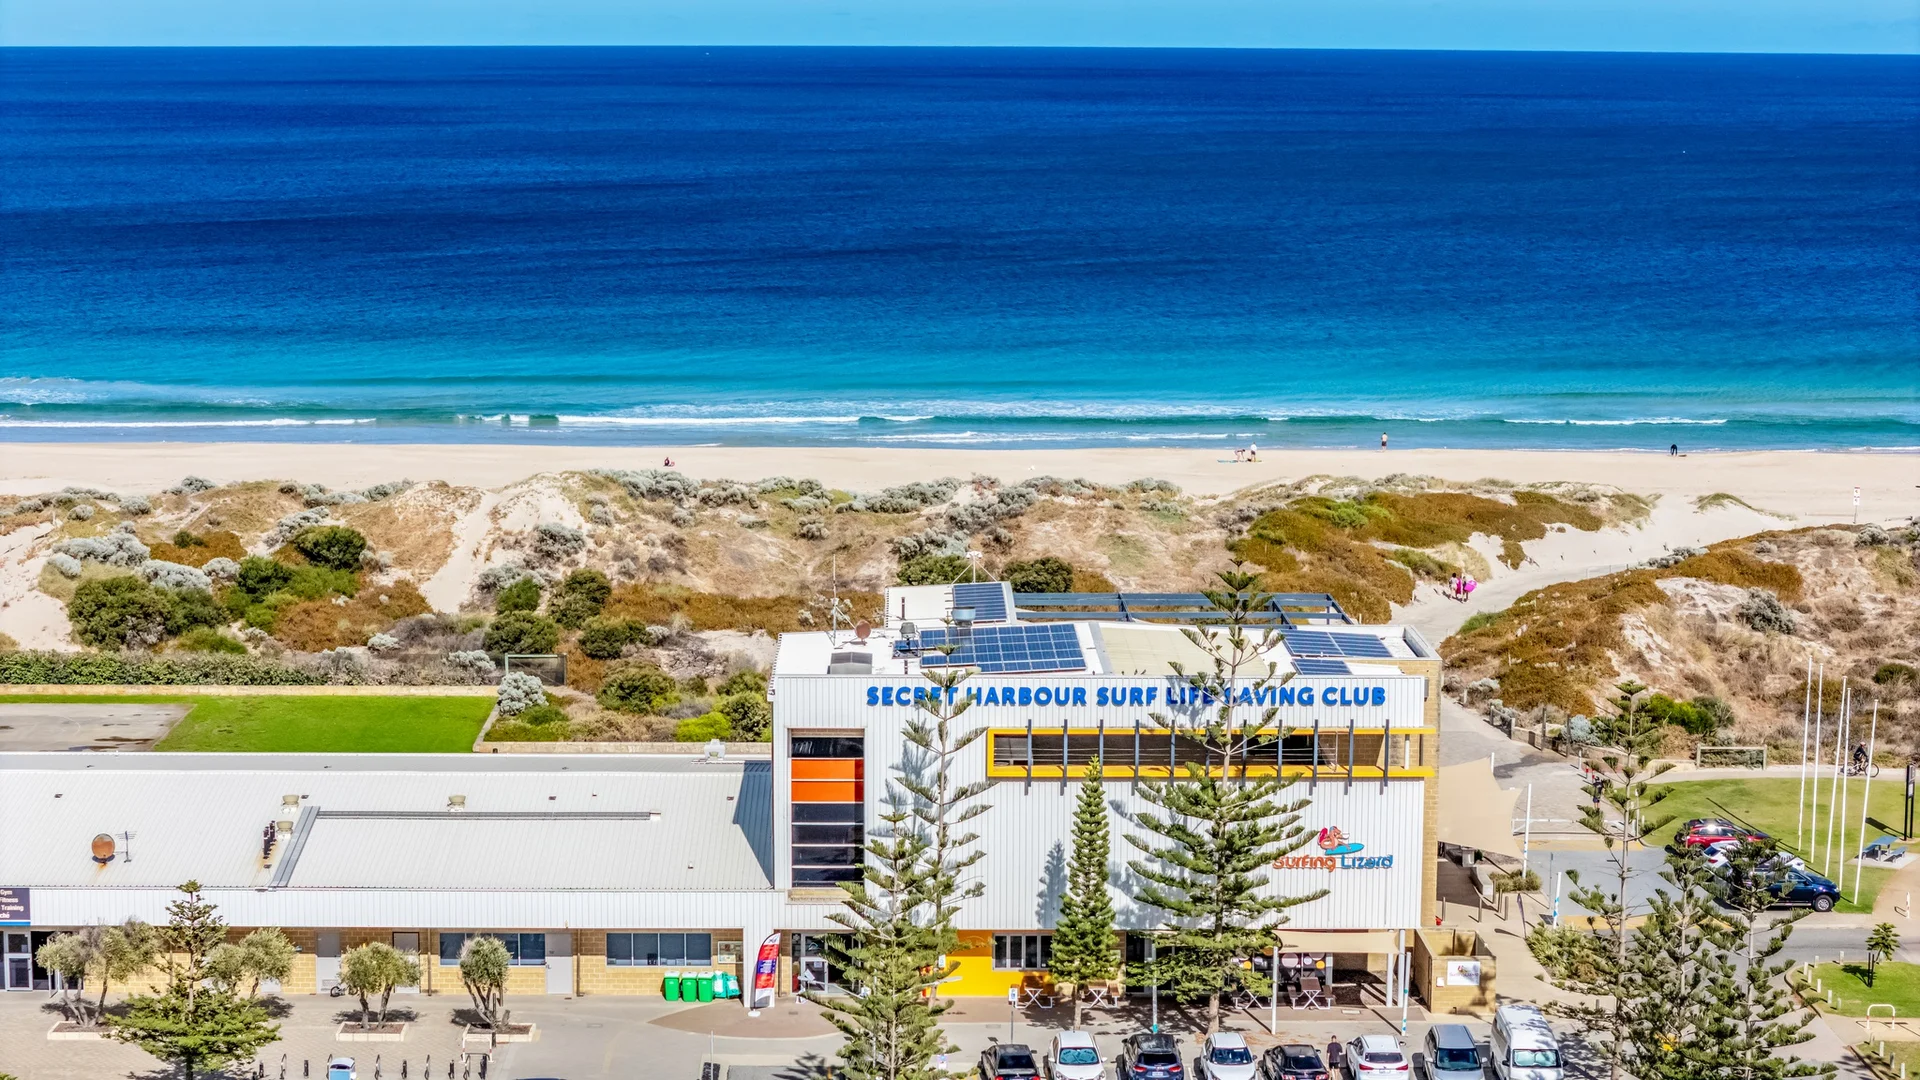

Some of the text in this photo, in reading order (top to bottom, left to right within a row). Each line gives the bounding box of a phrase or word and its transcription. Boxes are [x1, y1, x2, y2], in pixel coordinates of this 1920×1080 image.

[867, 686, 1386, 706] SECRET HARBOUR SURF LIFE SAVING CLUB
[1272, 855, 1393, 873] Surfing Lizard
